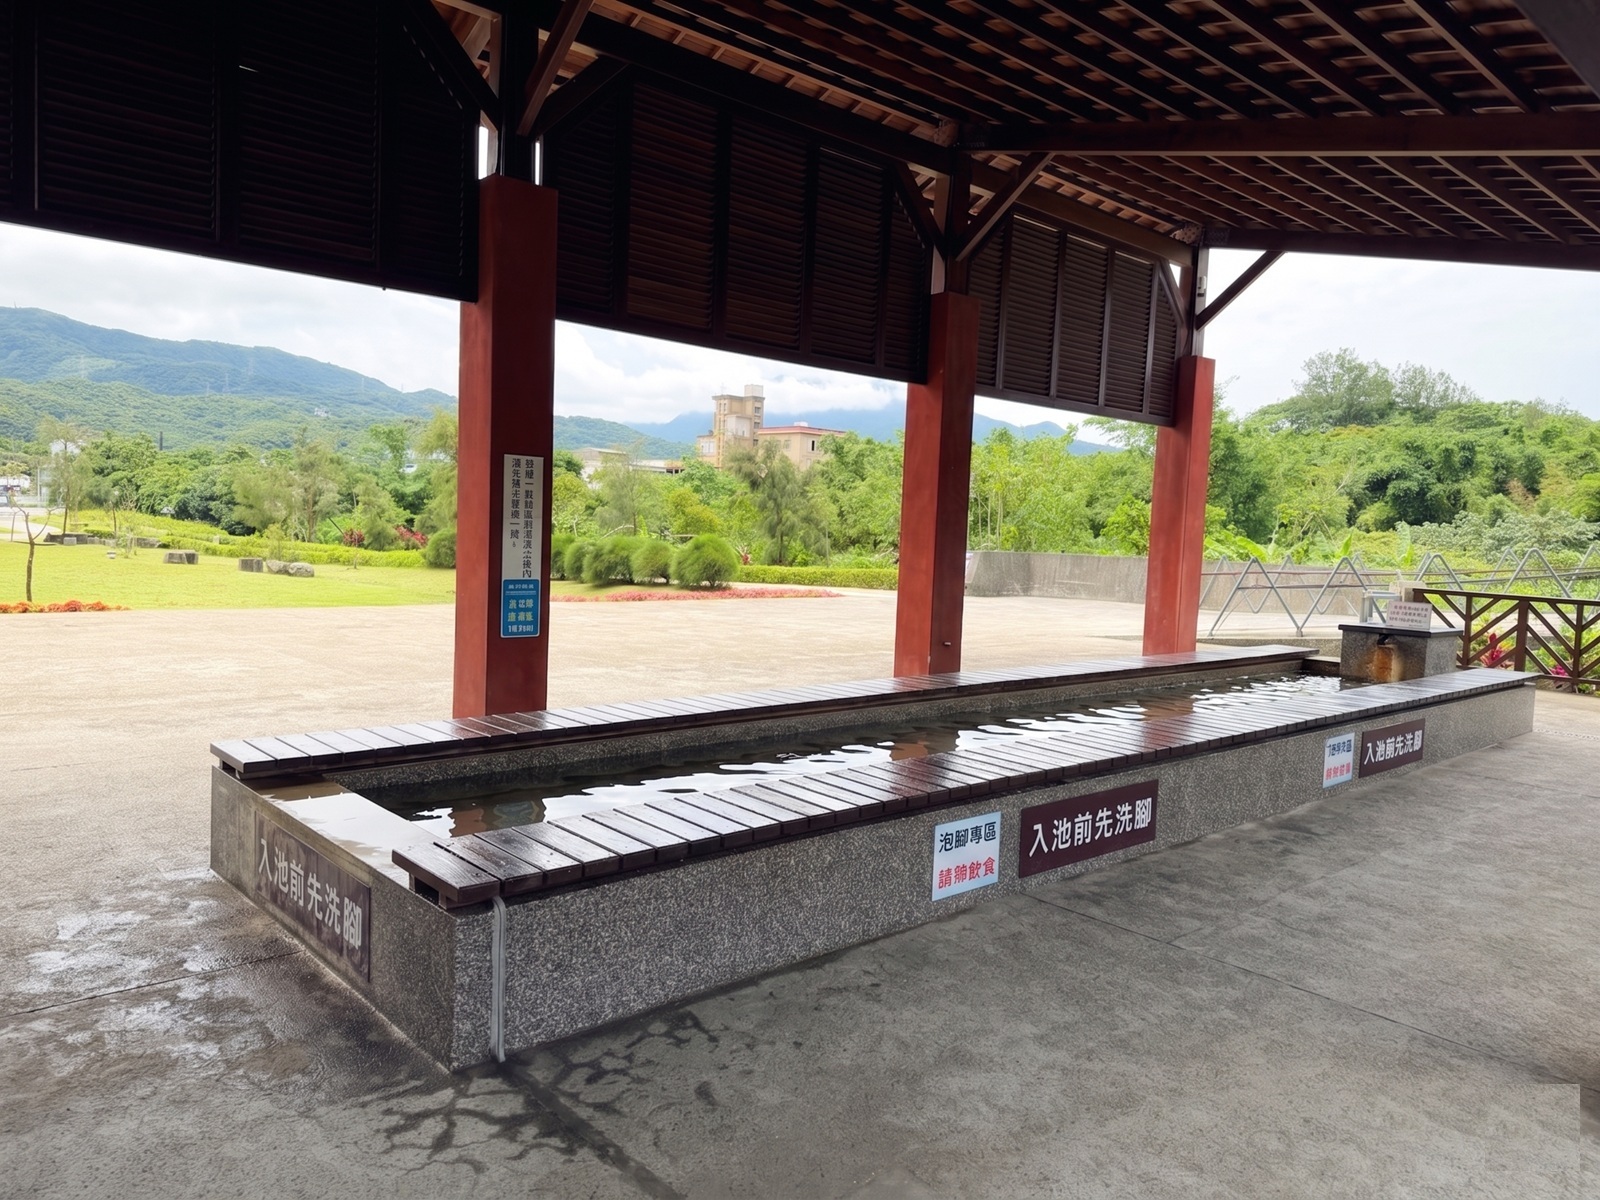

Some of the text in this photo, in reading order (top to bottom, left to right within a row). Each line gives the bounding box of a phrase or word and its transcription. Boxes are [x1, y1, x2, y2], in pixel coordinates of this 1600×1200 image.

[938, 821, 997, 853] 泡腳專區
[1029, 798, 1152, 857] 入池前先洗腳
[258, 838, 363, 950] 入池前先洗腳
